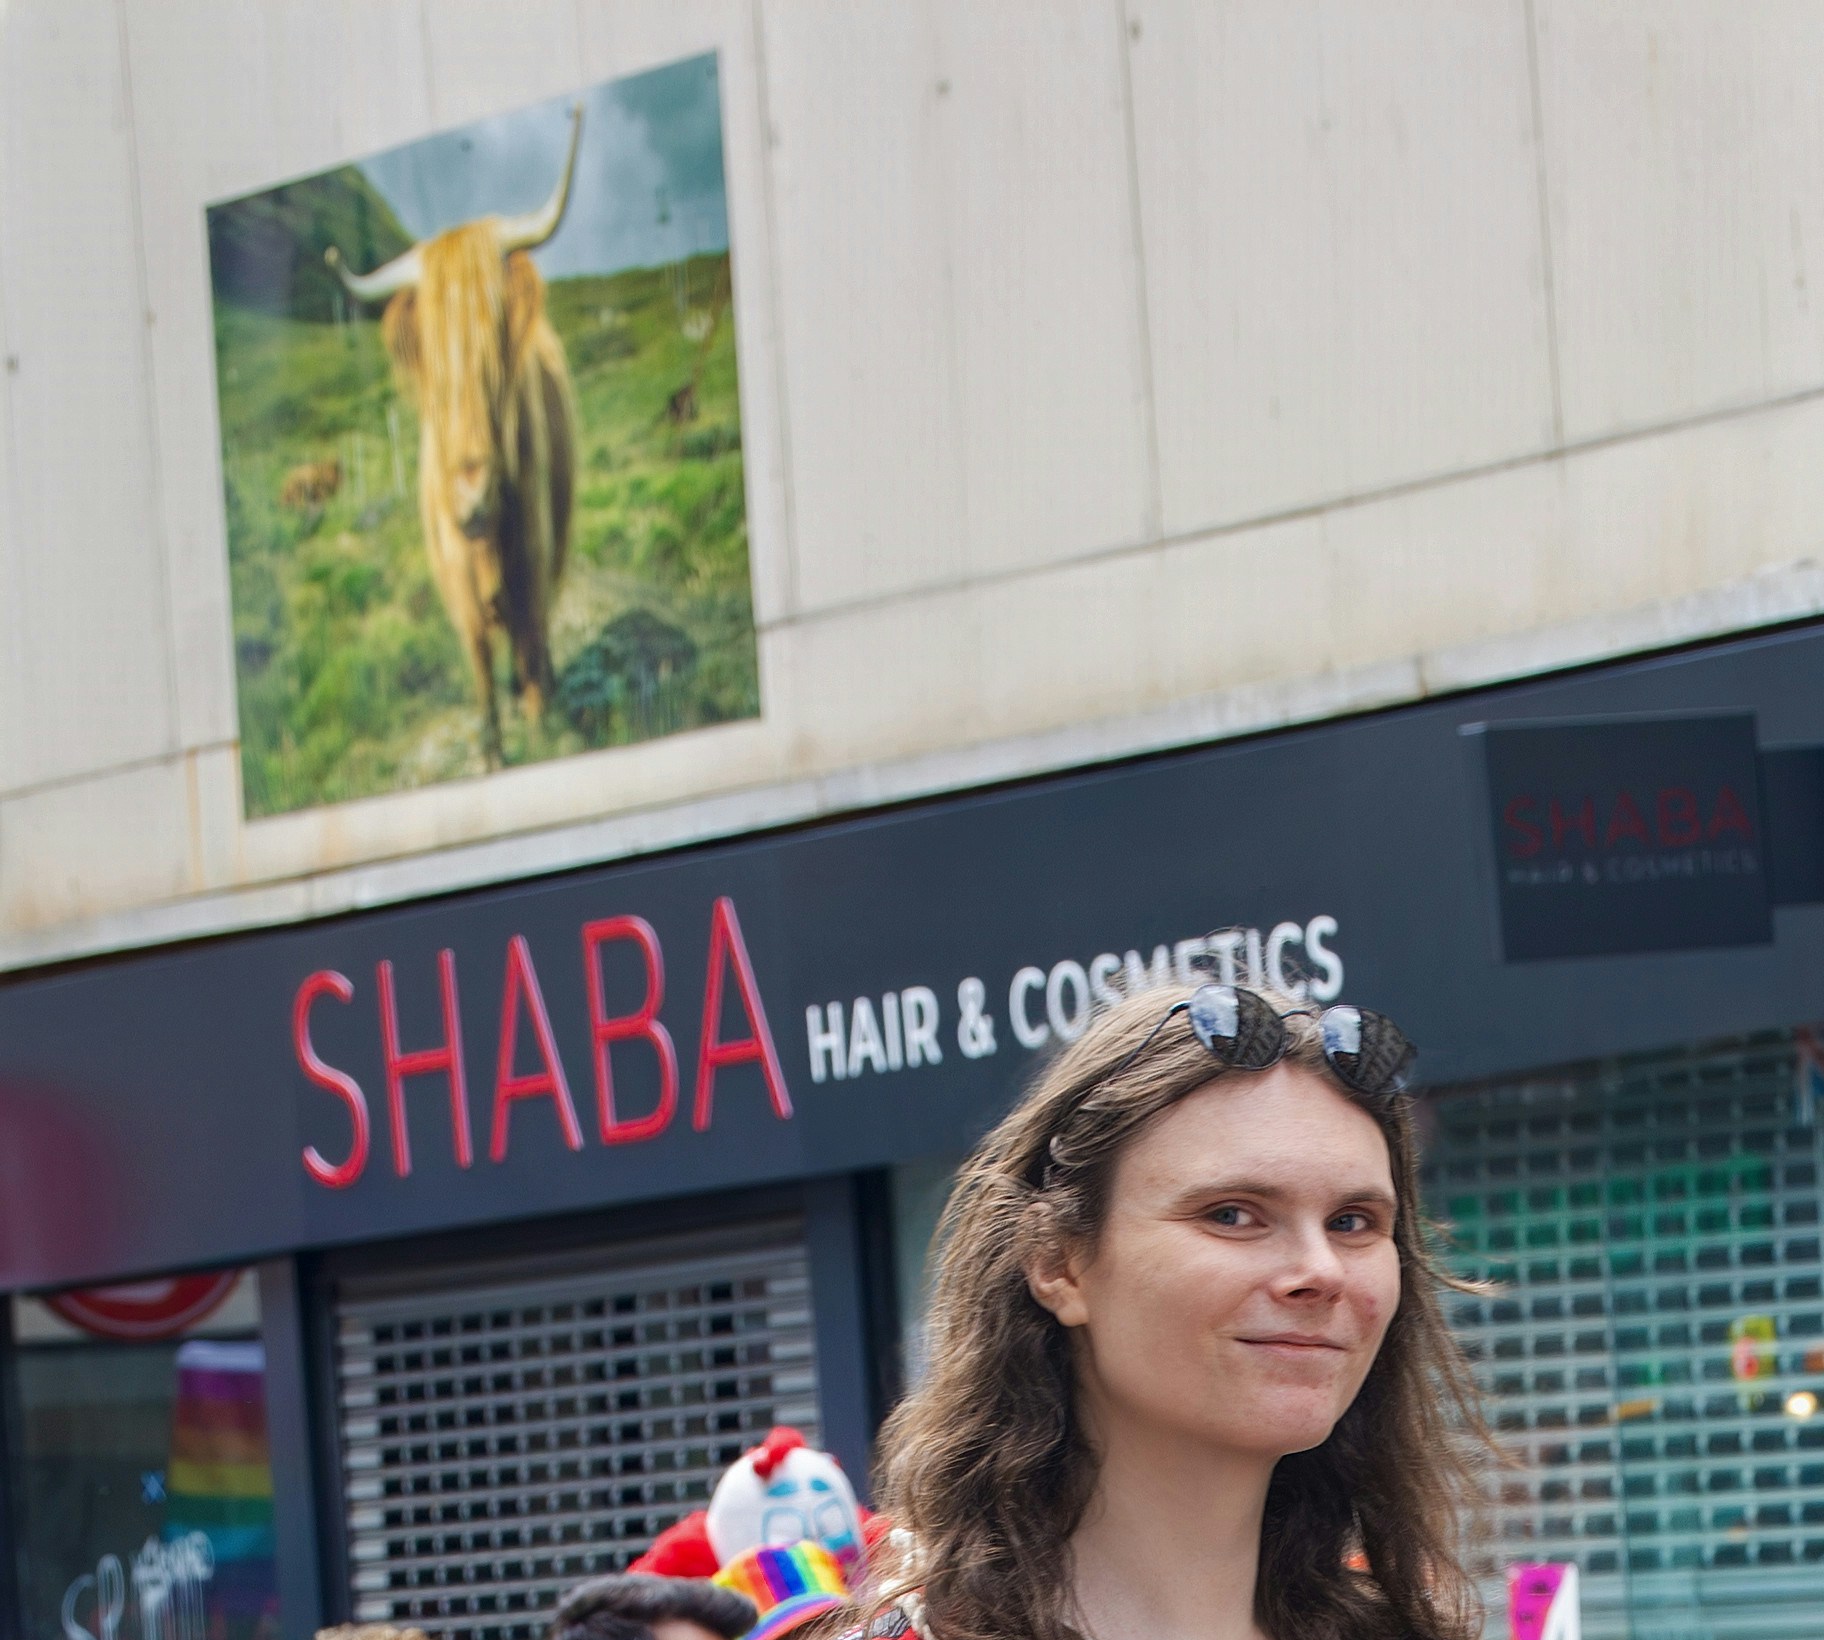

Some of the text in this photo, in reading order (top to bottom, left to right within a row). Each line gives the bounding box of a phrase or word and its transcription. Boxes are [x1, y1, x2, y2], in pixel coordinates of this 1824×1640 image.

[1503, 784, 1755, 858] SHABA
[292, 895, 793, 1188] SHABA
[805, 986, 943, 1083] HAIR
[957, 977, 997, 1059] &
